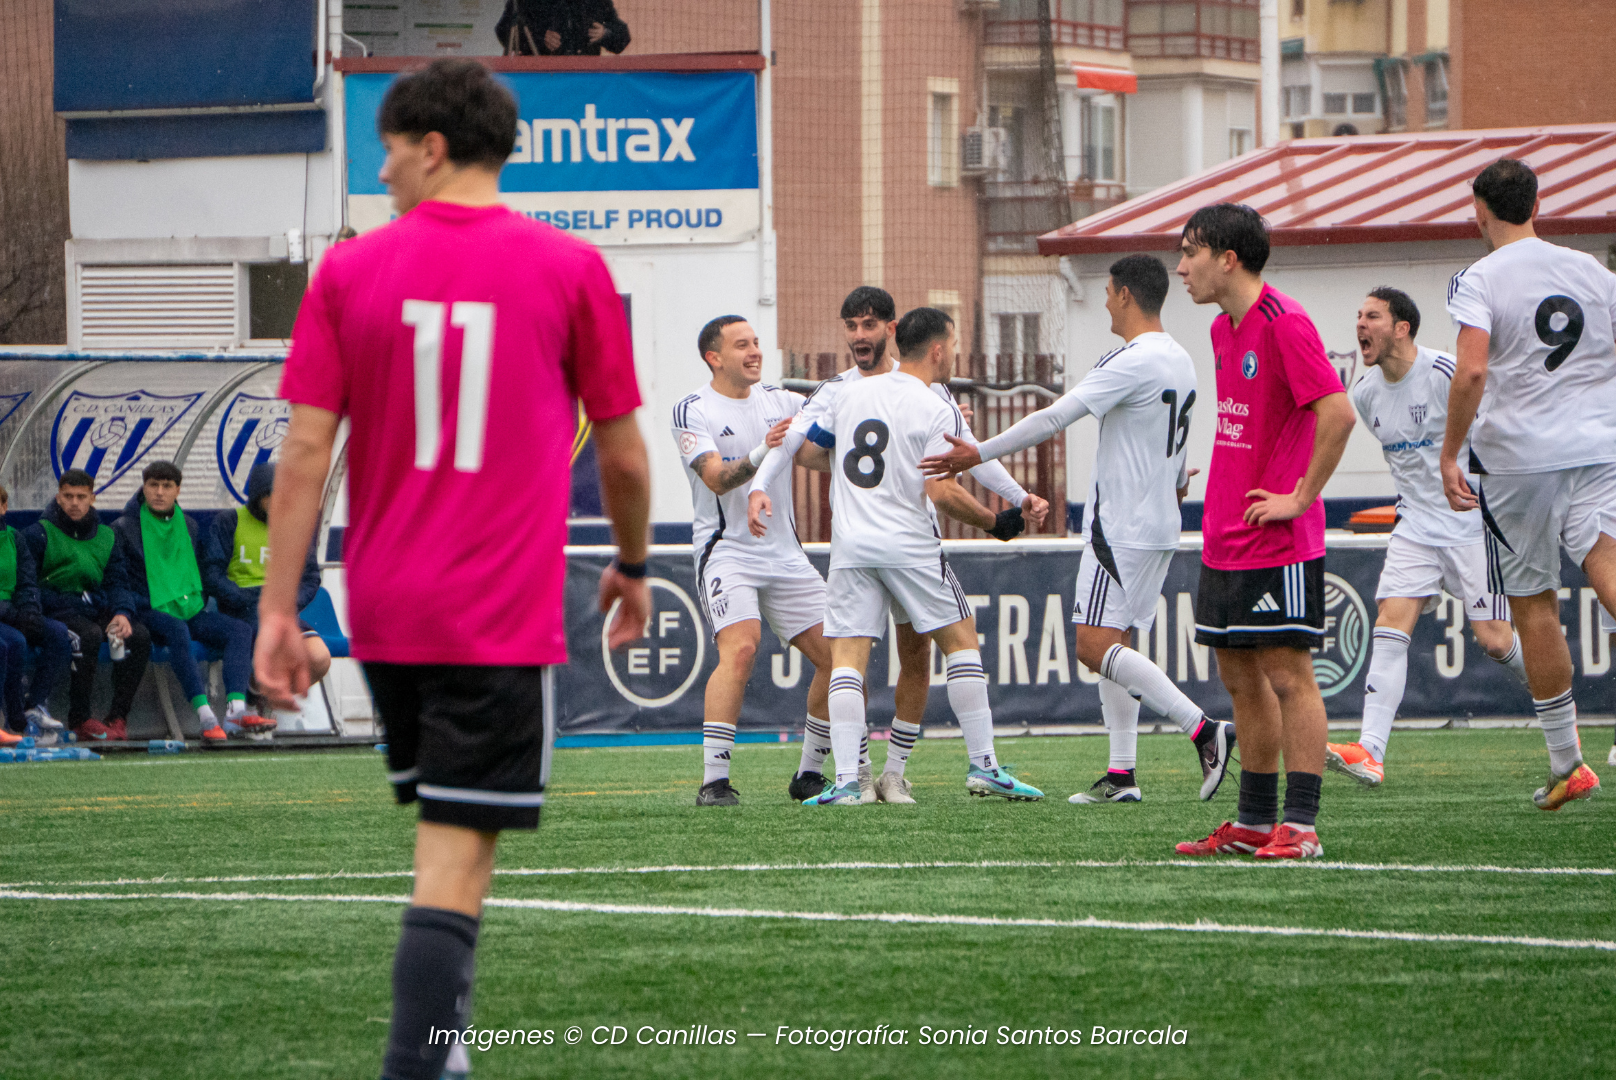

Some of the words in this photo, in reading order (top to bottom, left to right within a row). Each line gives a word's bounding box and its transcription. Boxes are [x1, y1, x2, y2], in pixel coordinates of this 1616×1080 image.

[506, 104, 696, 163] amtrax
[628, 208, 723, 229] PROUD
[1534, 294, 1585, 373] 9
[104, 404, 176, 414] CANILLAS
[401, 298, 497, 474] 11
[842, 418, 890, 490] 8
[1161, 388, 1197, 459] 16
[710, 576, 723, 598] 2
